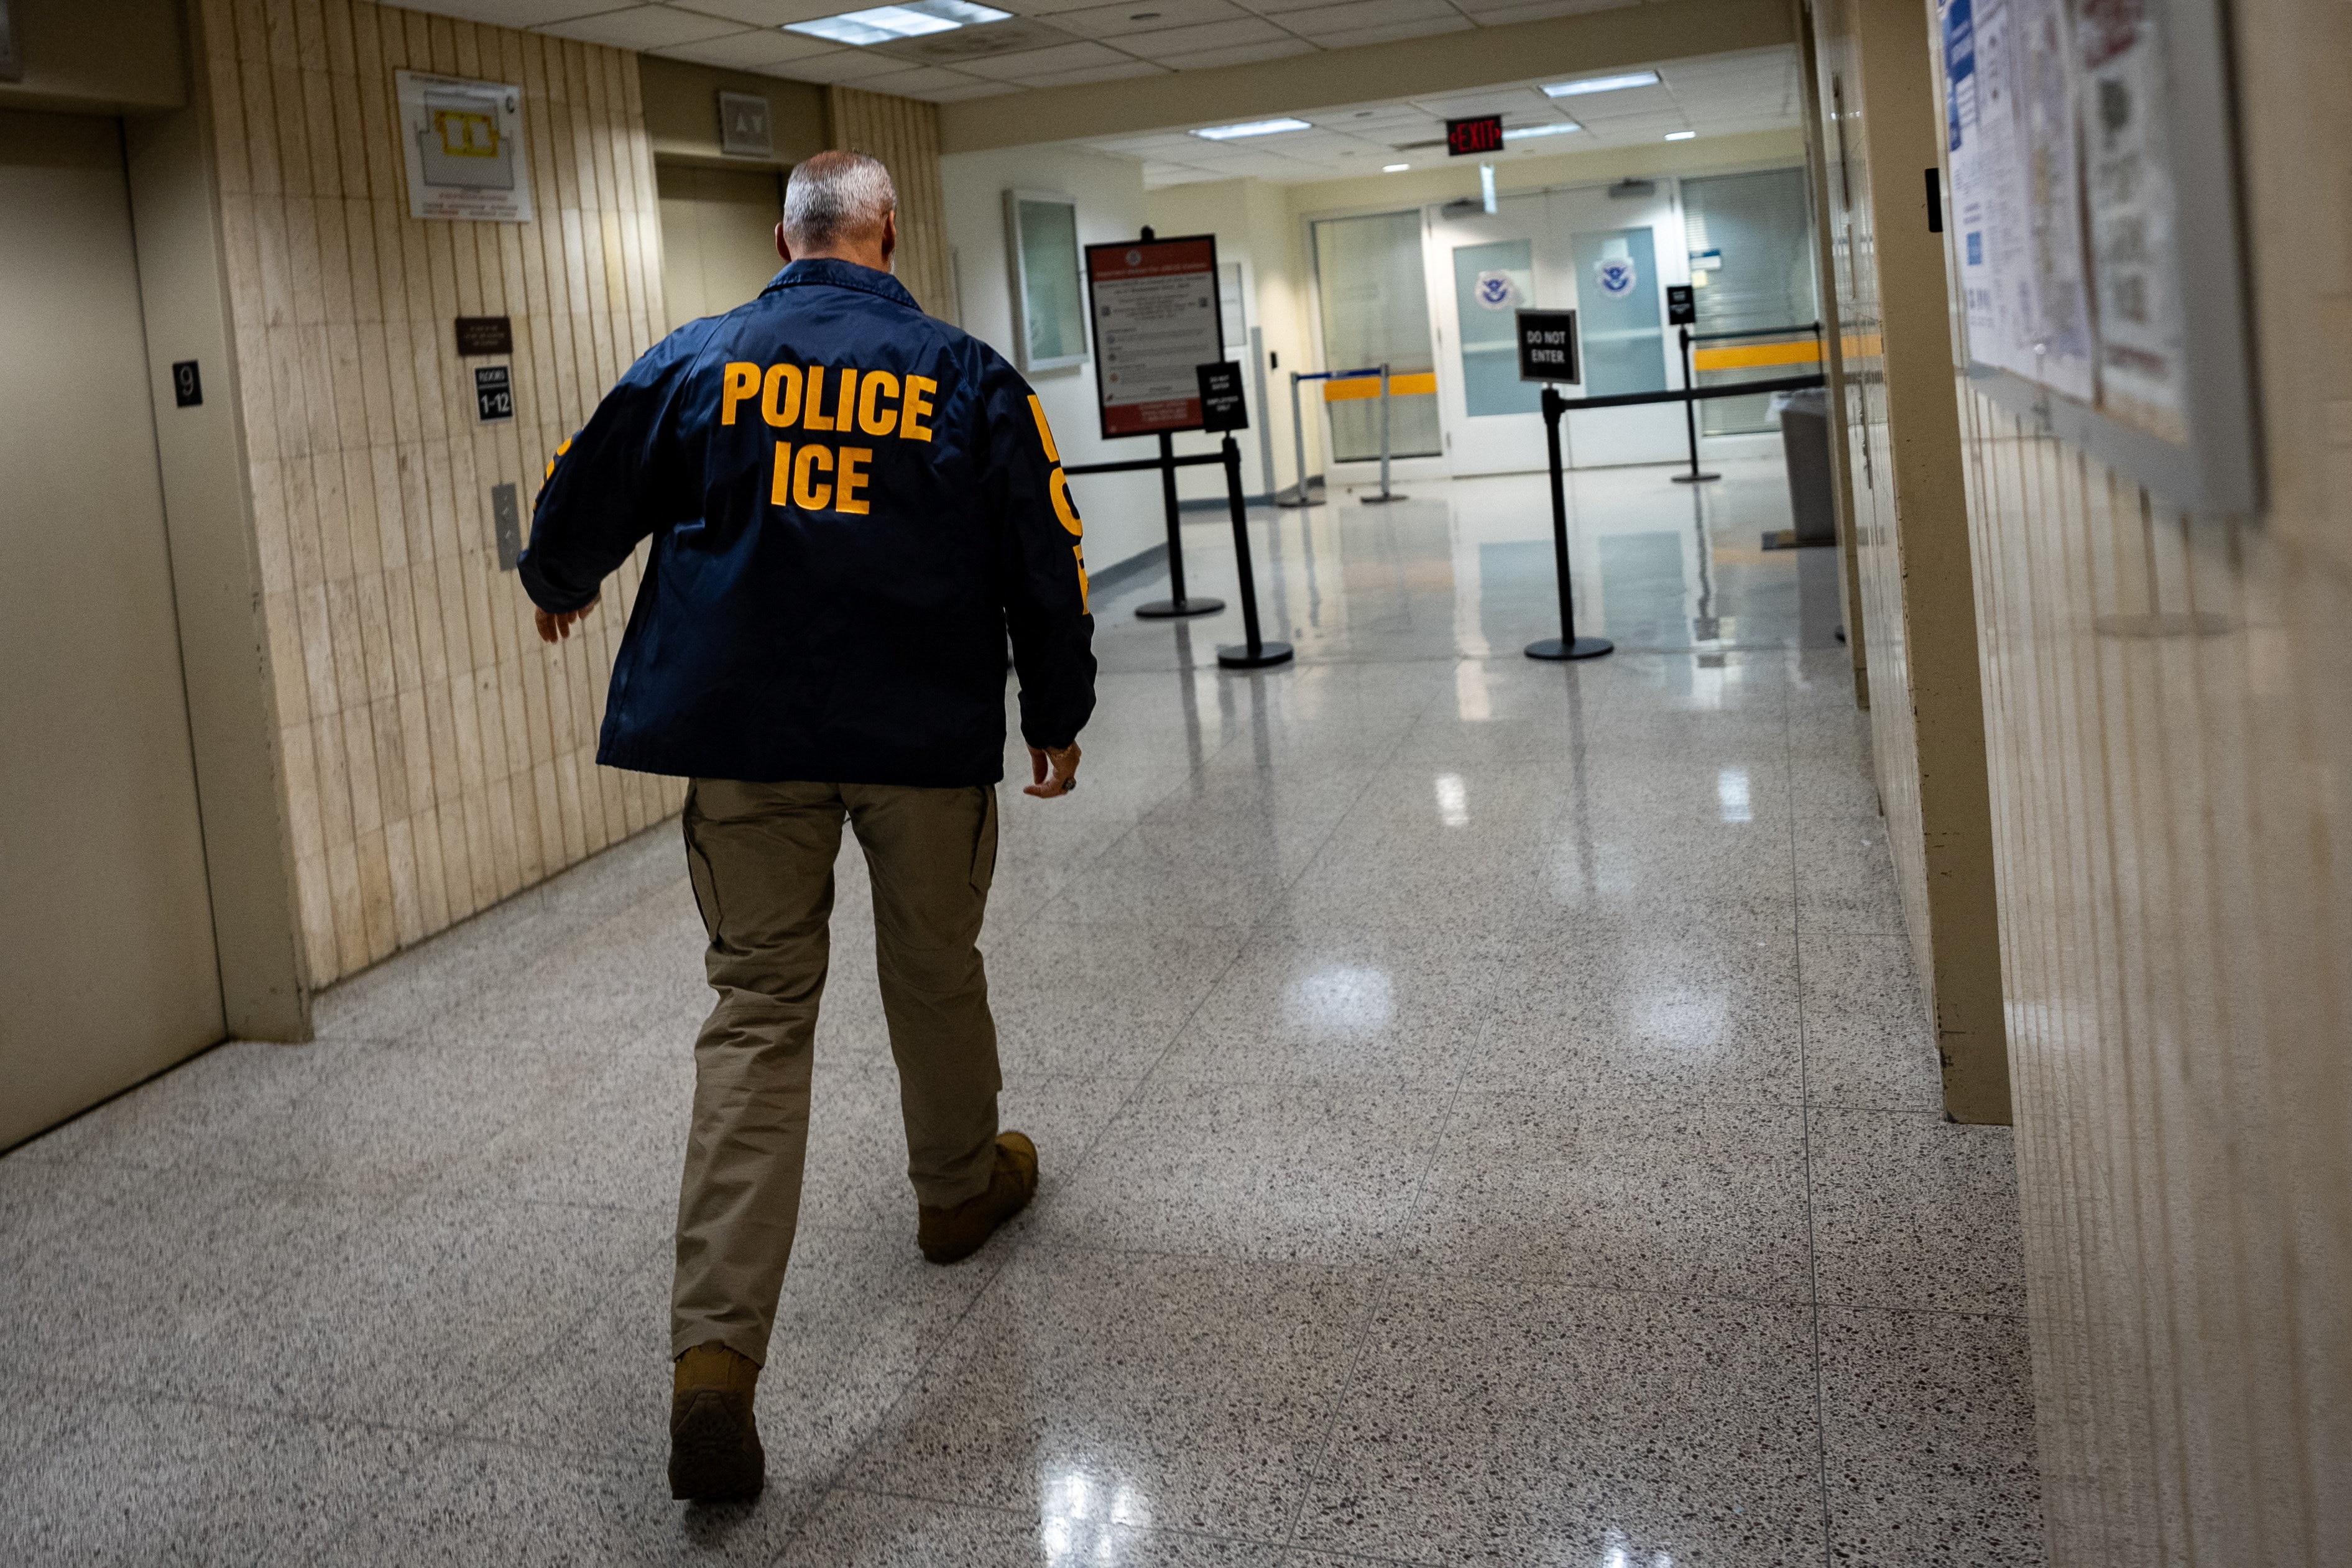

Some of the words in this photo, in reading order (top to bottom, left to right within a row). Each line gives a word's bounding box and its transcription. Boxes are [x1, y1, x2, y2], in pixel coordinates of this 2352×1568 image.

[1457, 120, 1495, 152] EXIT
[1527, 330, 1542, 344] DO
[1544, 331, 1566, 345] NOT
[1531, 349, 1565, 364] ENTER
[481, 392, 510, 415] 1-12
[722, 362, 937, 442] POLICE
[771, 440, 872, 515] ICE
